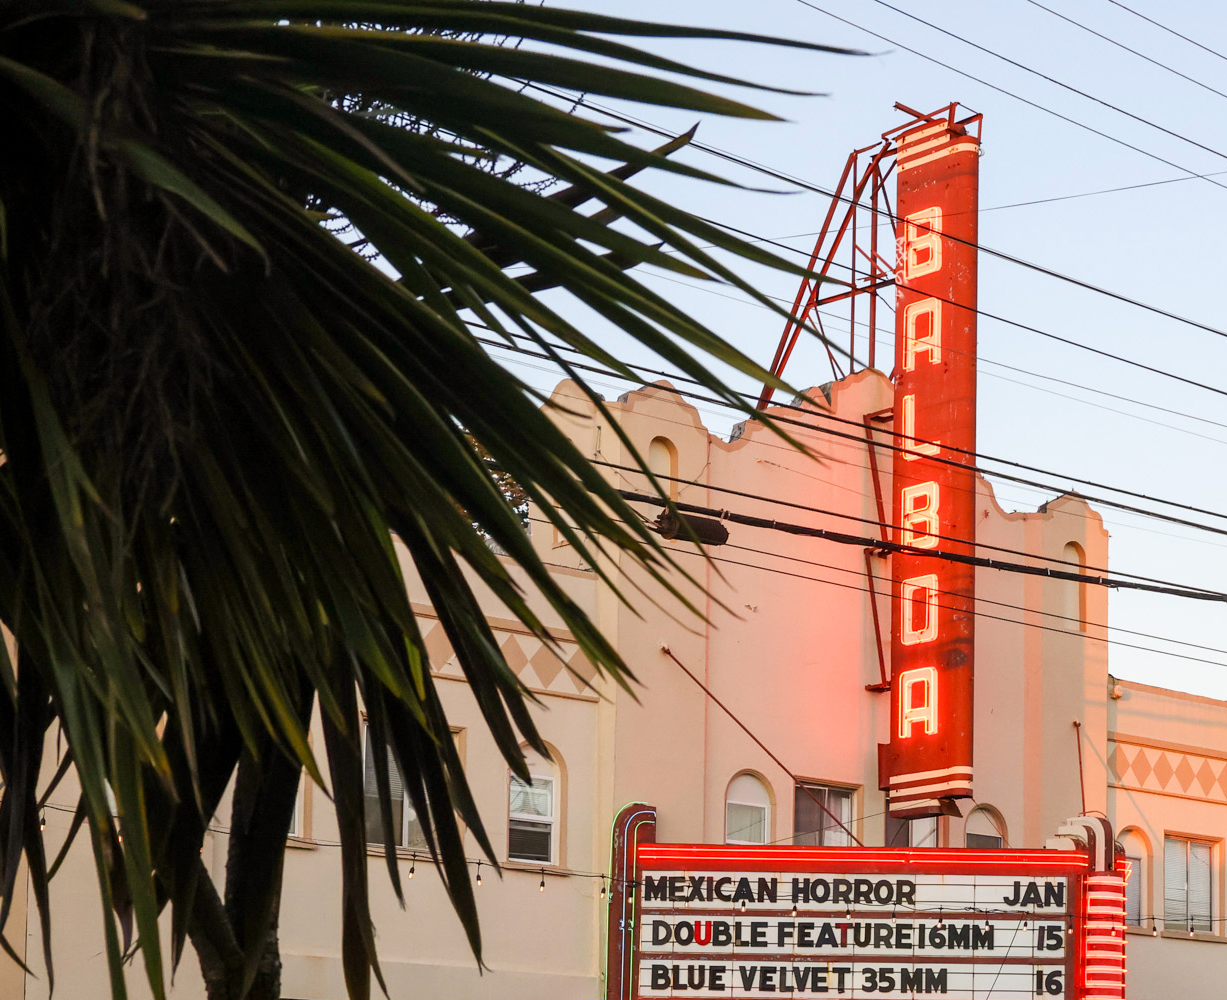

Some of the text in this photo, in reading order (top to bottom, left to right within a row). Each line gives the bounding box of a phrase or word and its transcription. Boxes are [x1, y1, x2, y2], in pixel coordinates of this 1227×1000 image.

[899, 206, 943, 739] BALBOA
[644, 875, 1064, 908] MEXICAN HORROR JAN
[652, 919, 1064, 951] DOUBLE FEATURE 16MM 15
[650, 964, 726, 991] BLUE
[739, 966, 851, 994] VELVET
[1036, 970, 1063, 996] 16
